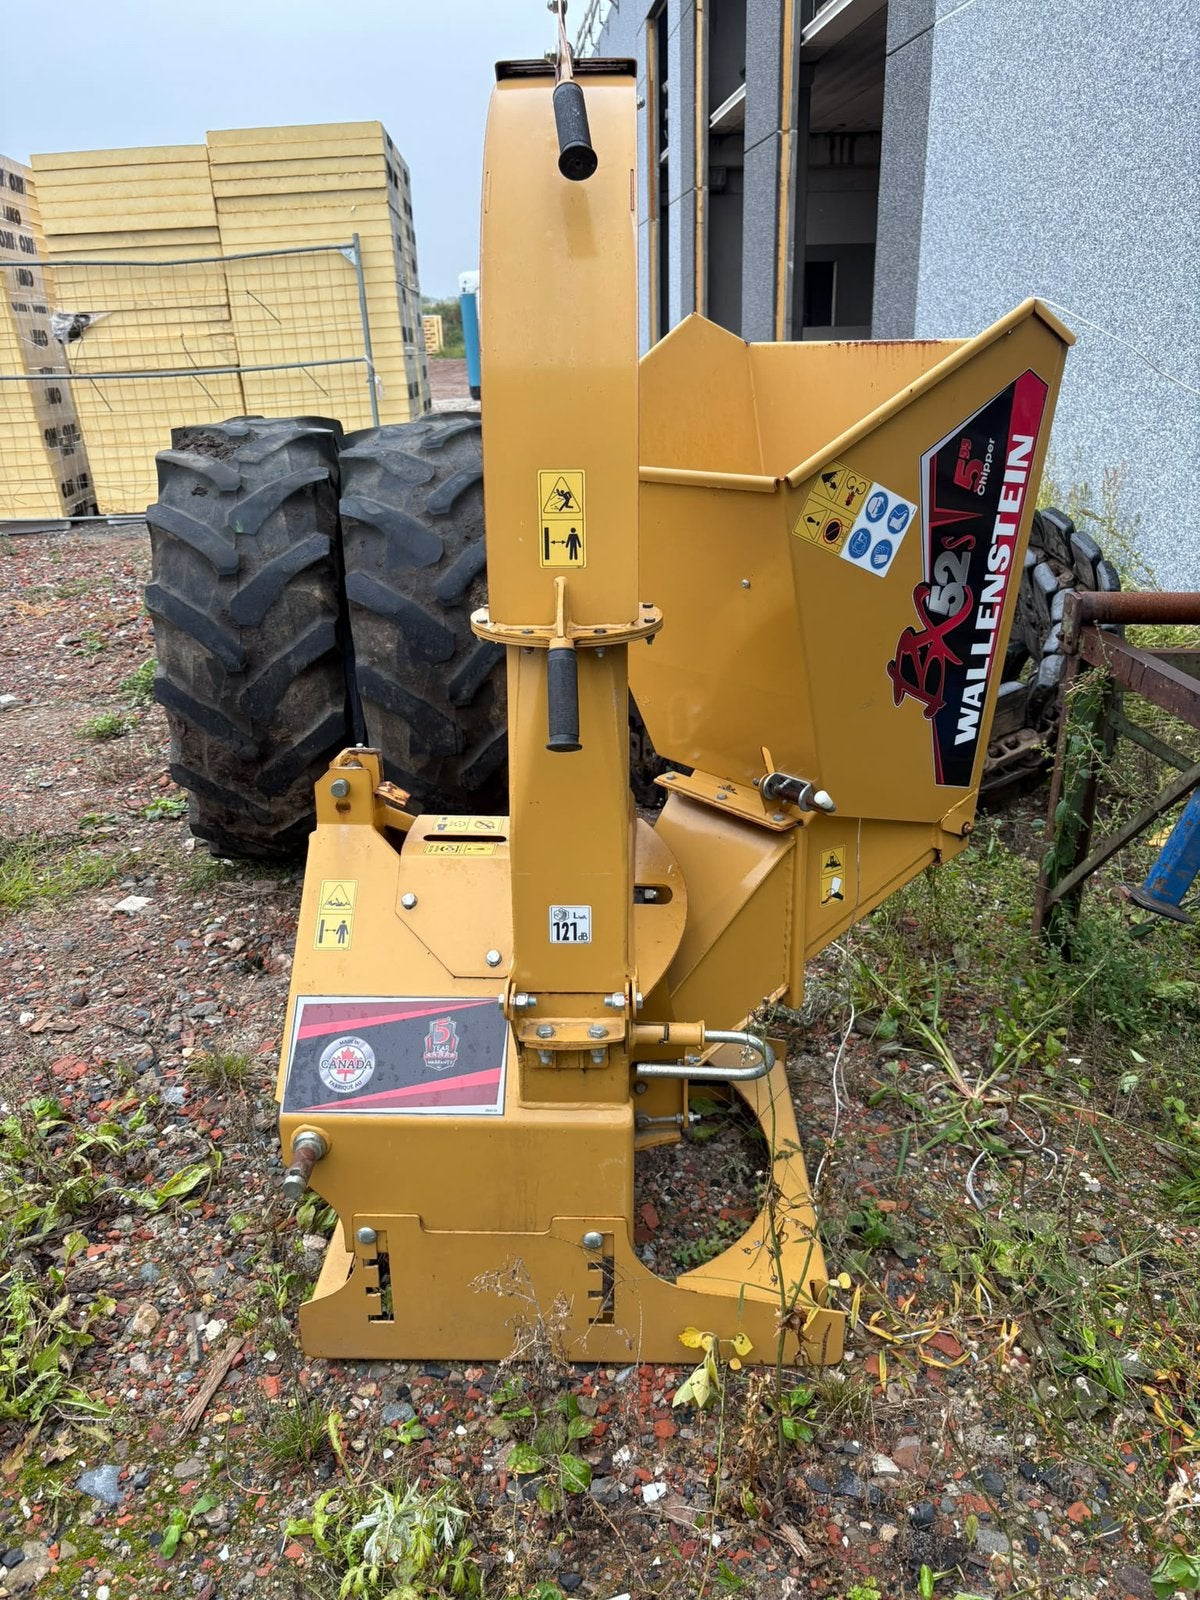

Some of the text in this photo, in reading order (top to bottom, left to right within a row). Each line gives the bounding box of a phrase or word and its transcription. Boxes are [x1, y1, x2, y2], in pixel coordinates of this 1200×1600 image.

[954, 434, 1034, 746] WALLENSTEIN
[553, 921, 589, 941] 121 dB
[433, 1016, 451, 1044] 5
[320, 1059, 373, 1069] CANADA
